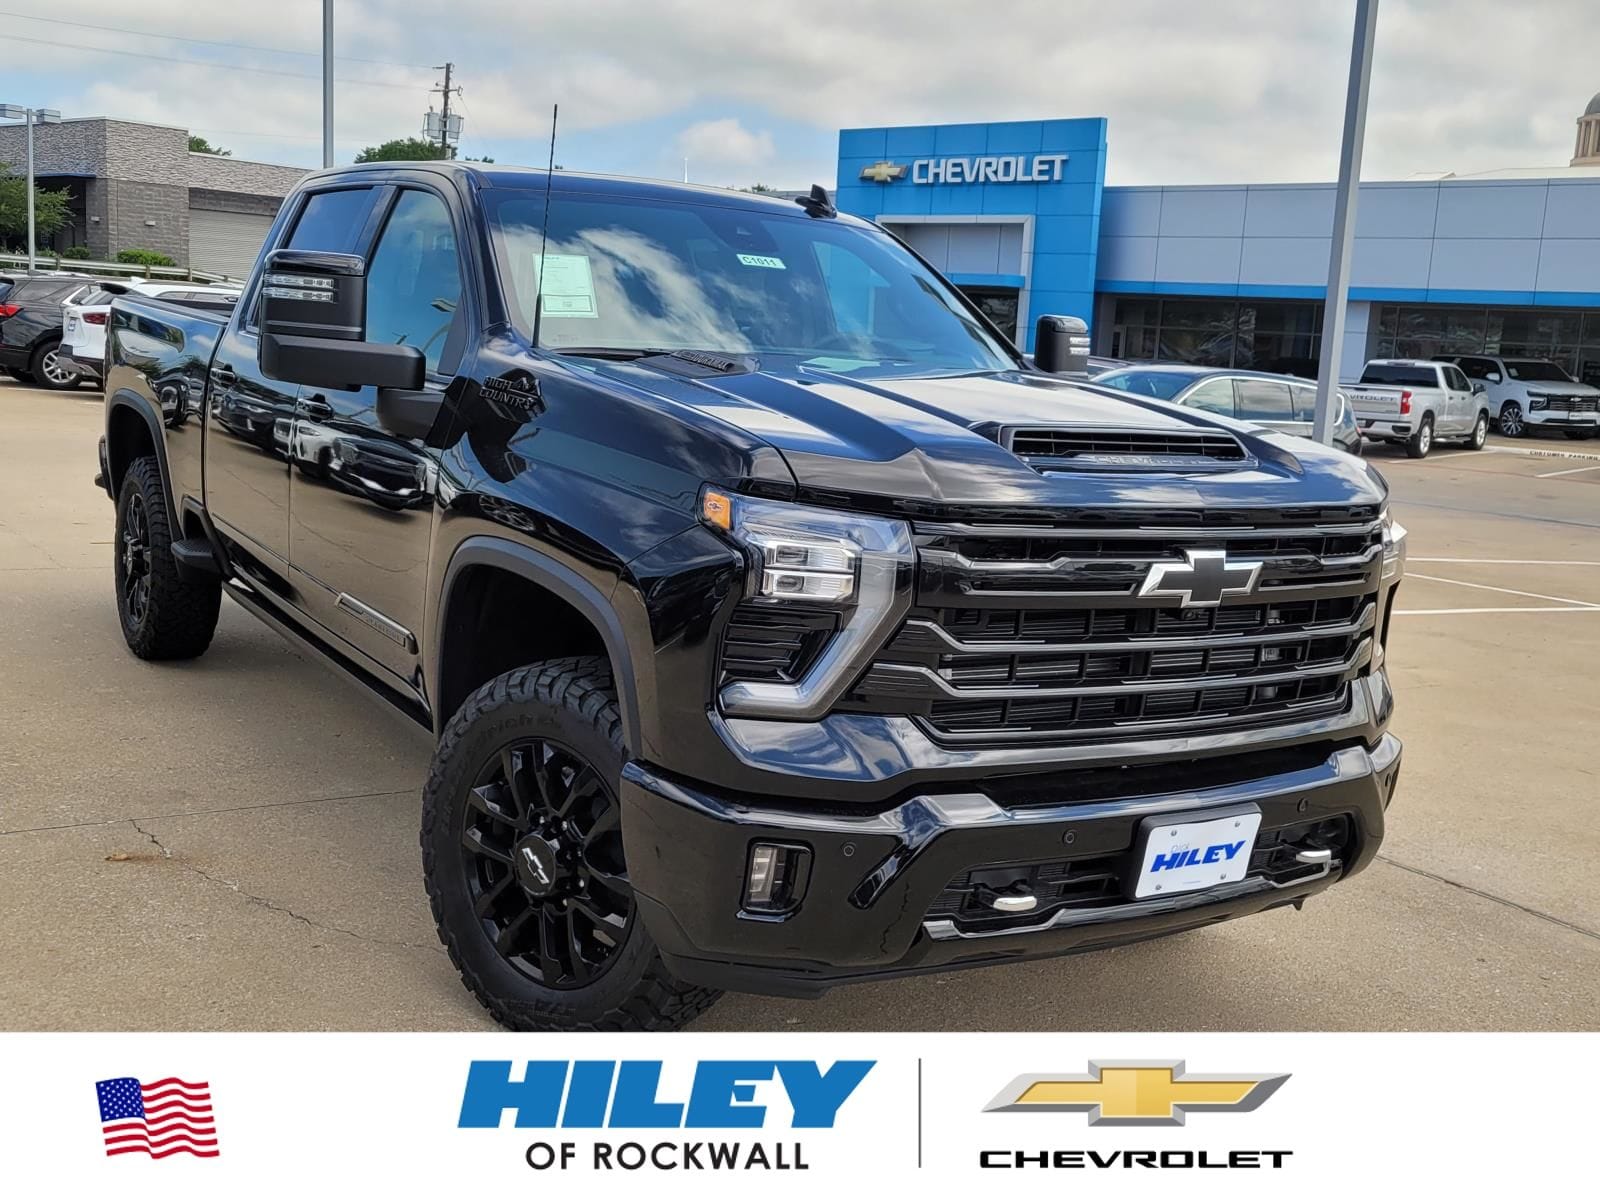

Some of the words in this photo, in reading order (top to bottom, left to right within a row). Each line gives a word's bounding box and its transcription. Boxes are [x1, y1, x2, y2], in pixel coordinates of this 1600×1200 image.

[912, 154, 1069, 184] CHEVROLET
[742, 256, 777, 267] C1011
[483, 376, 513, 391] HIGH
[479, 387, 533, 410] COUNTRY
[1150, 840, 1246, 873] HILEY
